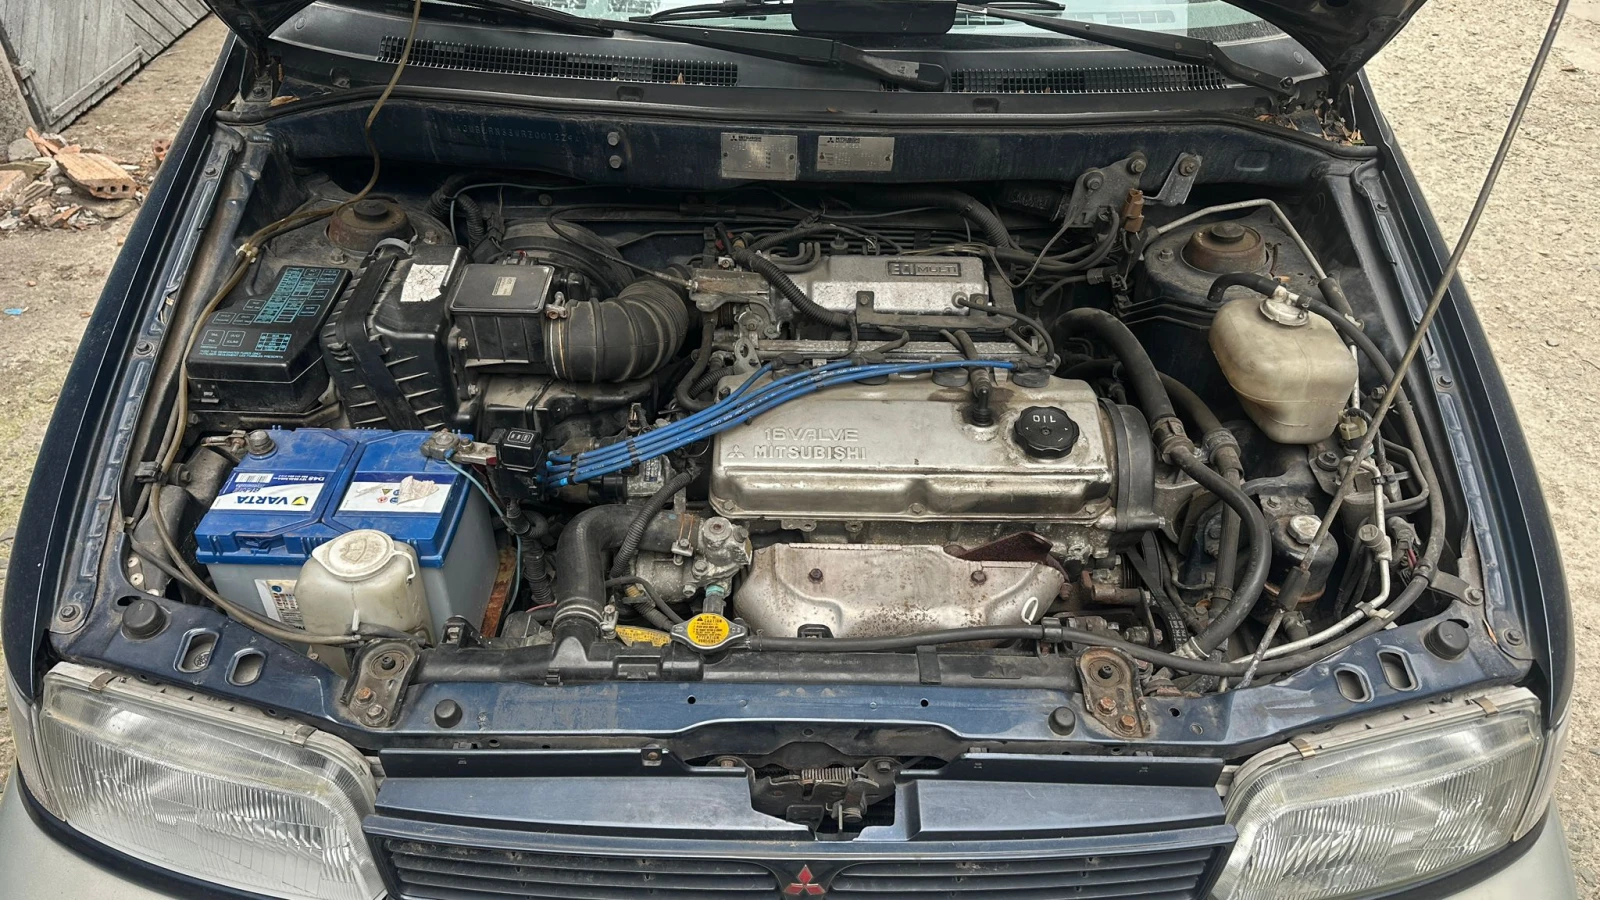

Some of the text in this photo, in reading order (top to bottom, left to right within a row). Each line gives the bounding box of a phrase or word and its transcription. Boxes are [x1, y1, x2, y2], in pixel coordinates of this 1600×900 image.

[916, 263, 957, 274] MULTI
[1032, 415, 1057, 423] OIL
[754, 445, 867, 460] MITSUBISHI
[237, 495, 288, 505] VARTA
